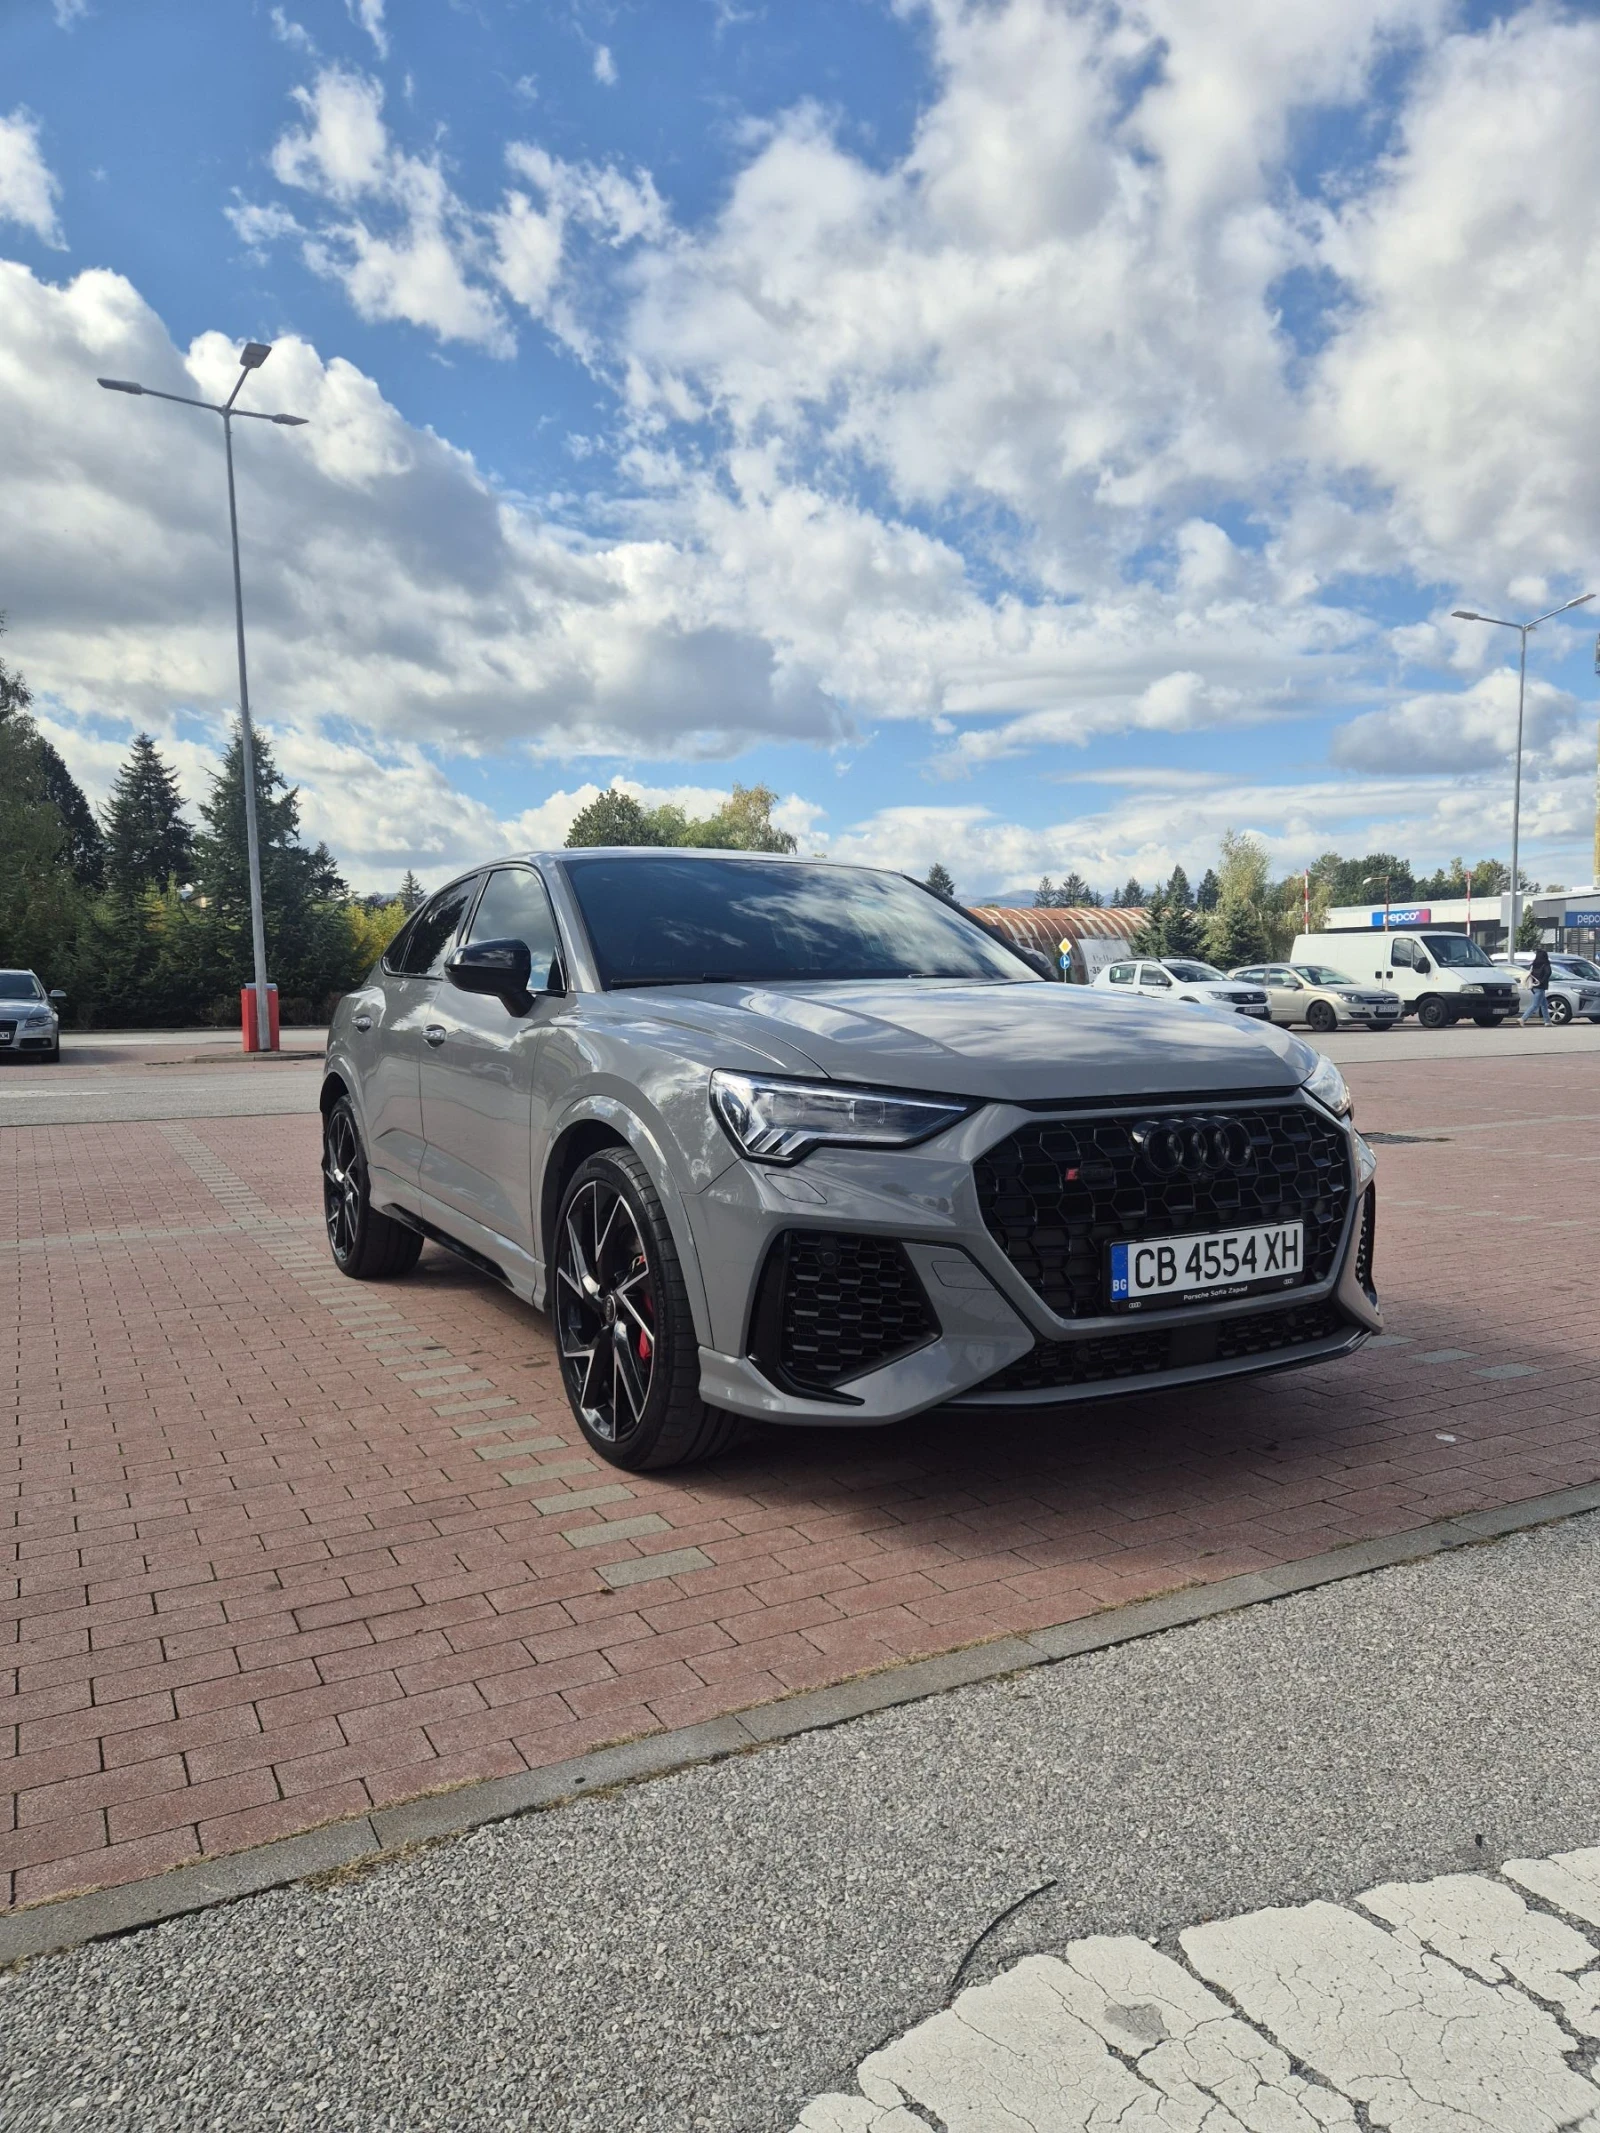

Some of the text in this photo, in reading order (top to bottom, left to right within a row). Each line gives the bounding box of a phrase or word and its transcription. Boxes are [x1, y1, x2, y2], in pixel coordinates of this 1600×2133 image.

[1135, 1229, 1298, 1289] CB 4554 XH
[1112, 1278, 1127, 1292] BG
[1183, 1285, 1248, 1300] Porsche Sofia Zapad
